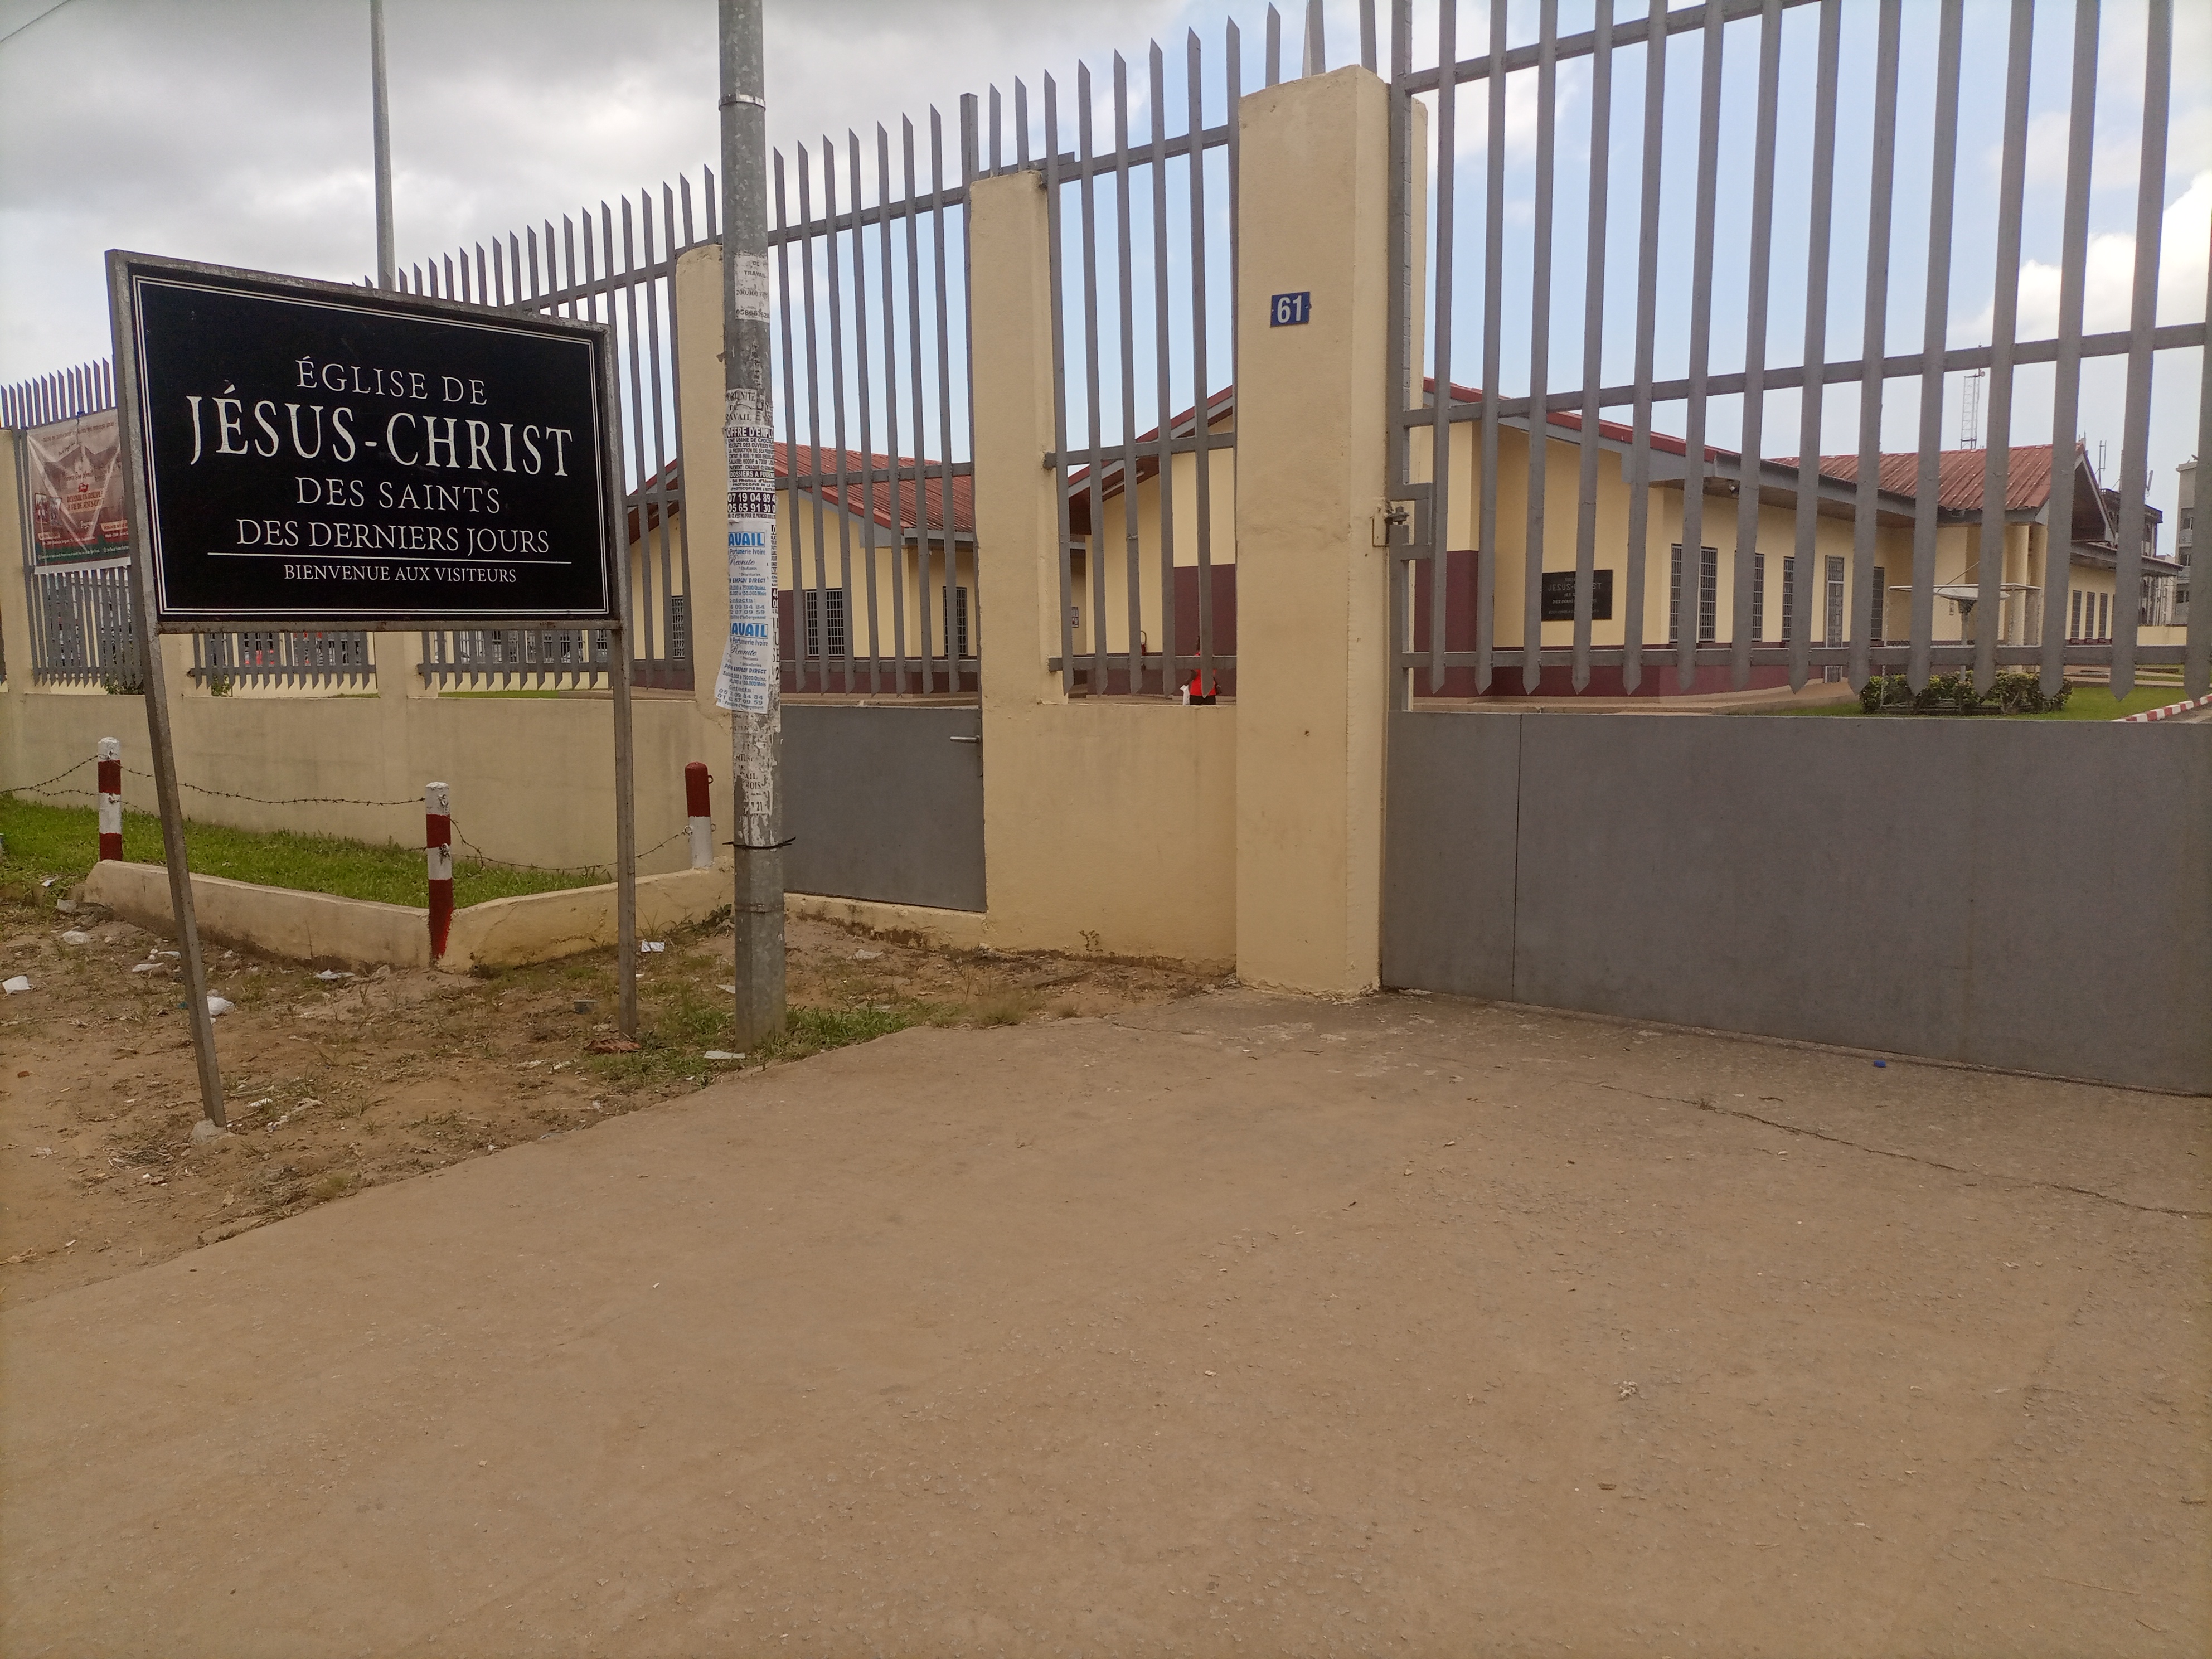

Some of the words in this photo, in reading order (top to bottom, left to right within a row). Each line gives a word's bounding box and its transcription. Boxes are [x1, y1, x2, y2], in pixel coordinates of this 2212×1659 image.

[1277, 295, 1302, 323] 61
[295, 356, 428, 399] ÉGLISE
[442, 376, 488, 405] DE
[186, 383, 573, 476] JÉSUS-CHRIST
[727, 427, 747, 438] OFFRE
[295, 477, 365, 507] DES
[379, 481, 499, 513] SAINTS
[727, 493, 736, 503] 07
[738, 493, 748, 502] 19
[750, 493, 761, 502] 04
[763, 493, 771, 503] 89
[727, 503, 736, 512] 05
[738, 503, 748, 512] 65
[750, 503, 761, 512] 91
[763, 504, 771, 513] 30
[236, 518, 299, 546] DES
[308, 522, 459, 551] DERNIERS
[466, 528, 549, 556] JOURS
[729, 533, 764, 546] AVAIL
[284, 565, 390, 580] BIENVENUE
[395, 567, 430, 581] AUX
[434, 567, 516, 583] VISITEURS
[732, 623, 768, 637] AVAIL
